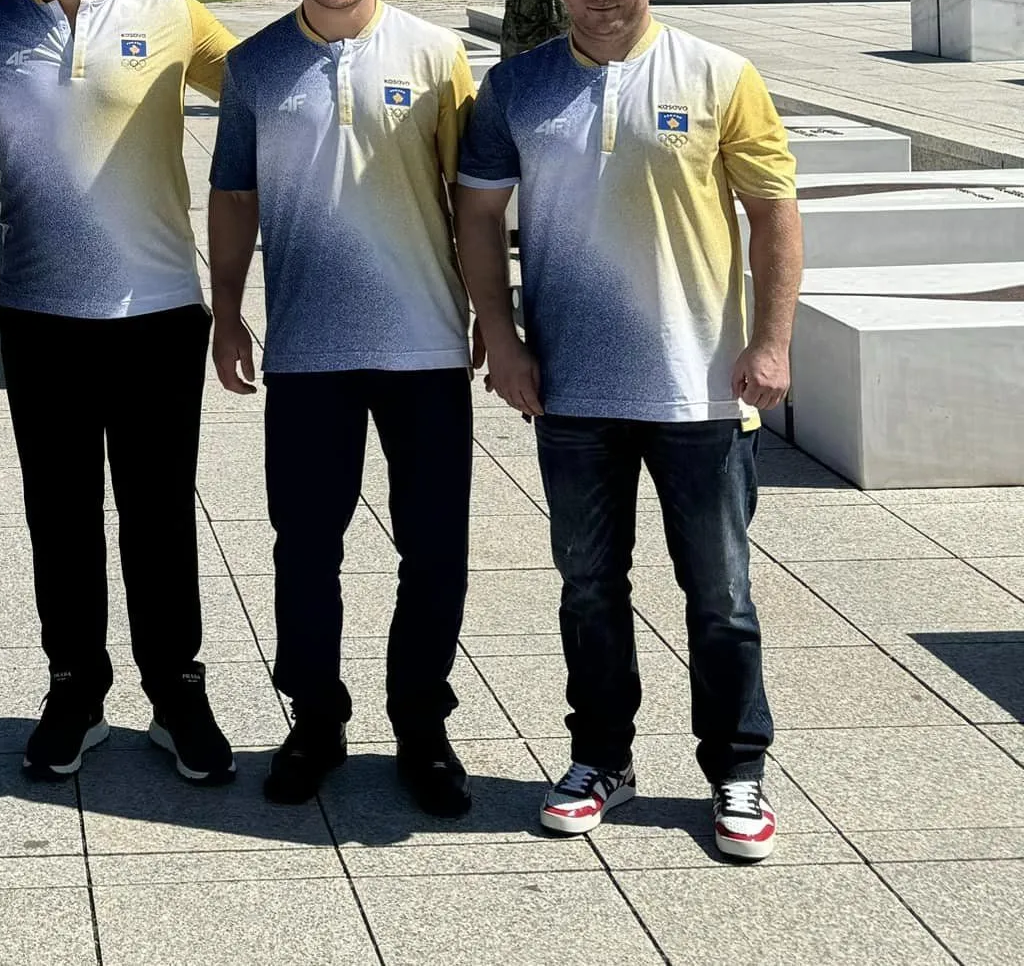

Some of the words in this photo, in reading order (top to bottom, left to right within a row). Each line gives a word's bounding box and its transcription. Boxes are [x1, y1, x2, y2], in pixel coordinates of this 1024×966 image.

[6, 48, 34, 66] 4F
[278, 93, 307, 114] 4F
[658, 104, 688, 112] KOSOVO
[534, 117, 568, 135] 4F
